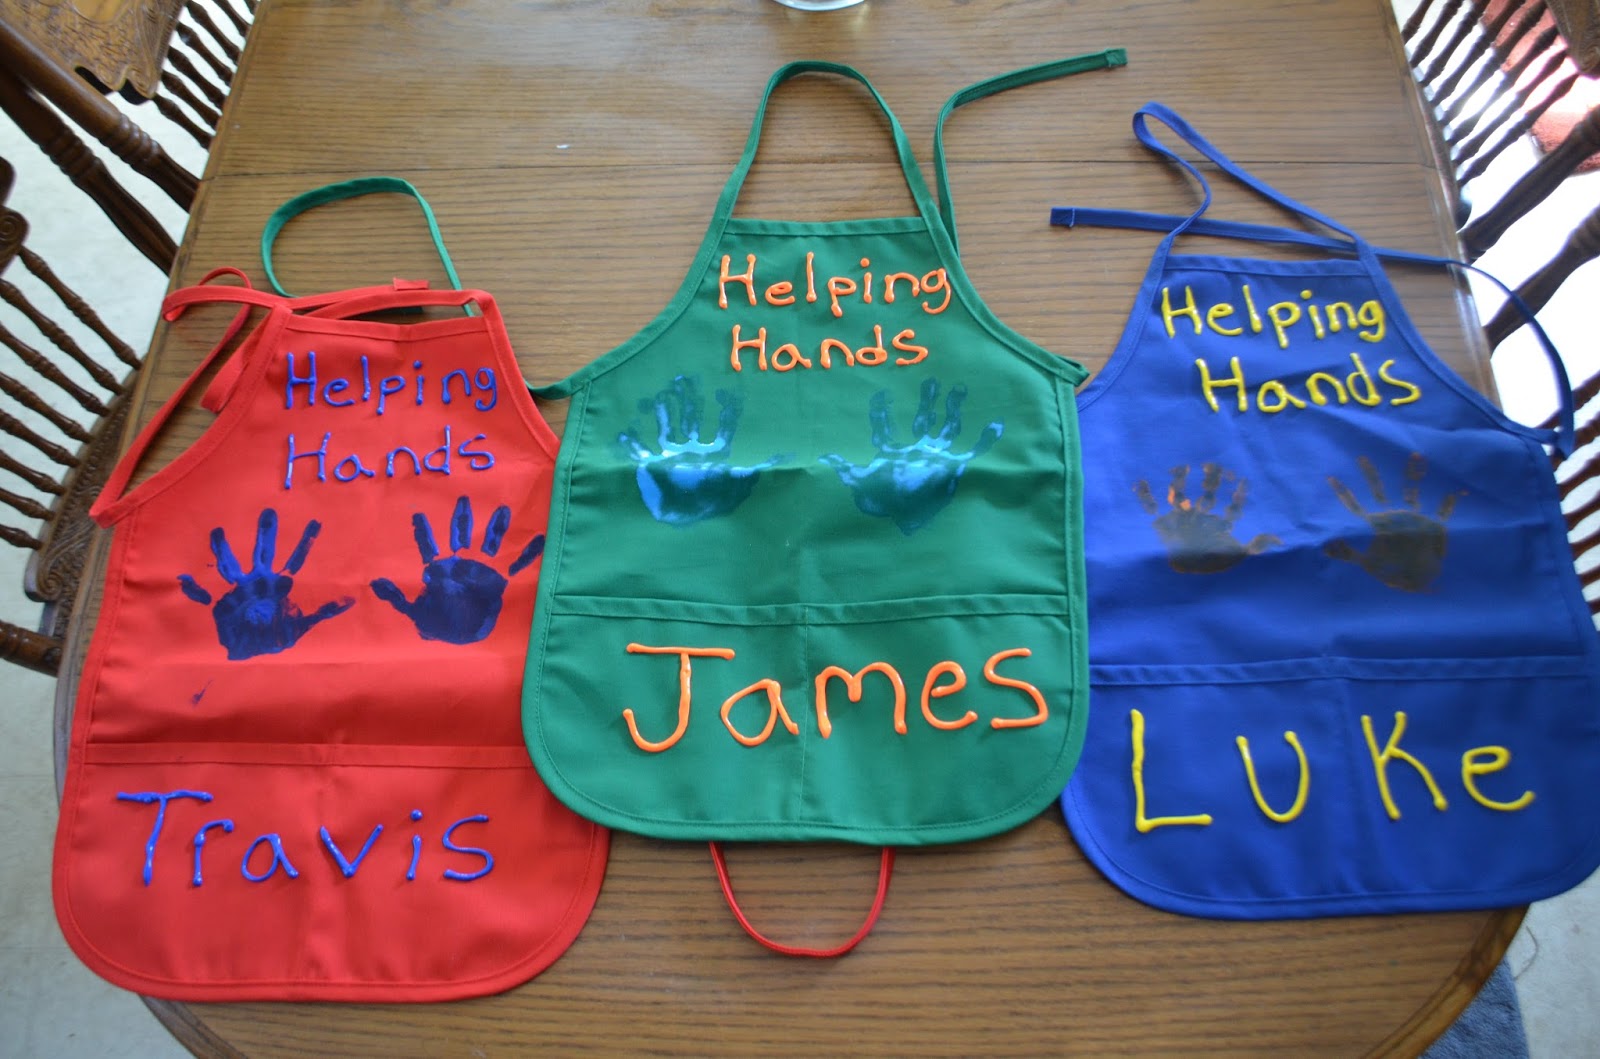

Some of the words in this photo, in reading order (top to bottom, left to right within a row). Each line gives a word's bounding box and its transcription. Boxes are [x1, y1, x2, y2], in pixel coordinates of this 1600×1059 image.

[718, 252, 952, 317] Helping
[730, 324, 929, 372] Hands
[1158, 286, 1387, 348] Helping
[285, 351, 498, 415] Helping
[1194, 353, 1421, 413] Hands
[284, 425, 496, 489] Hands
[622, 643, 1049, 753] James
[116, 791, 494, 886] Travis
